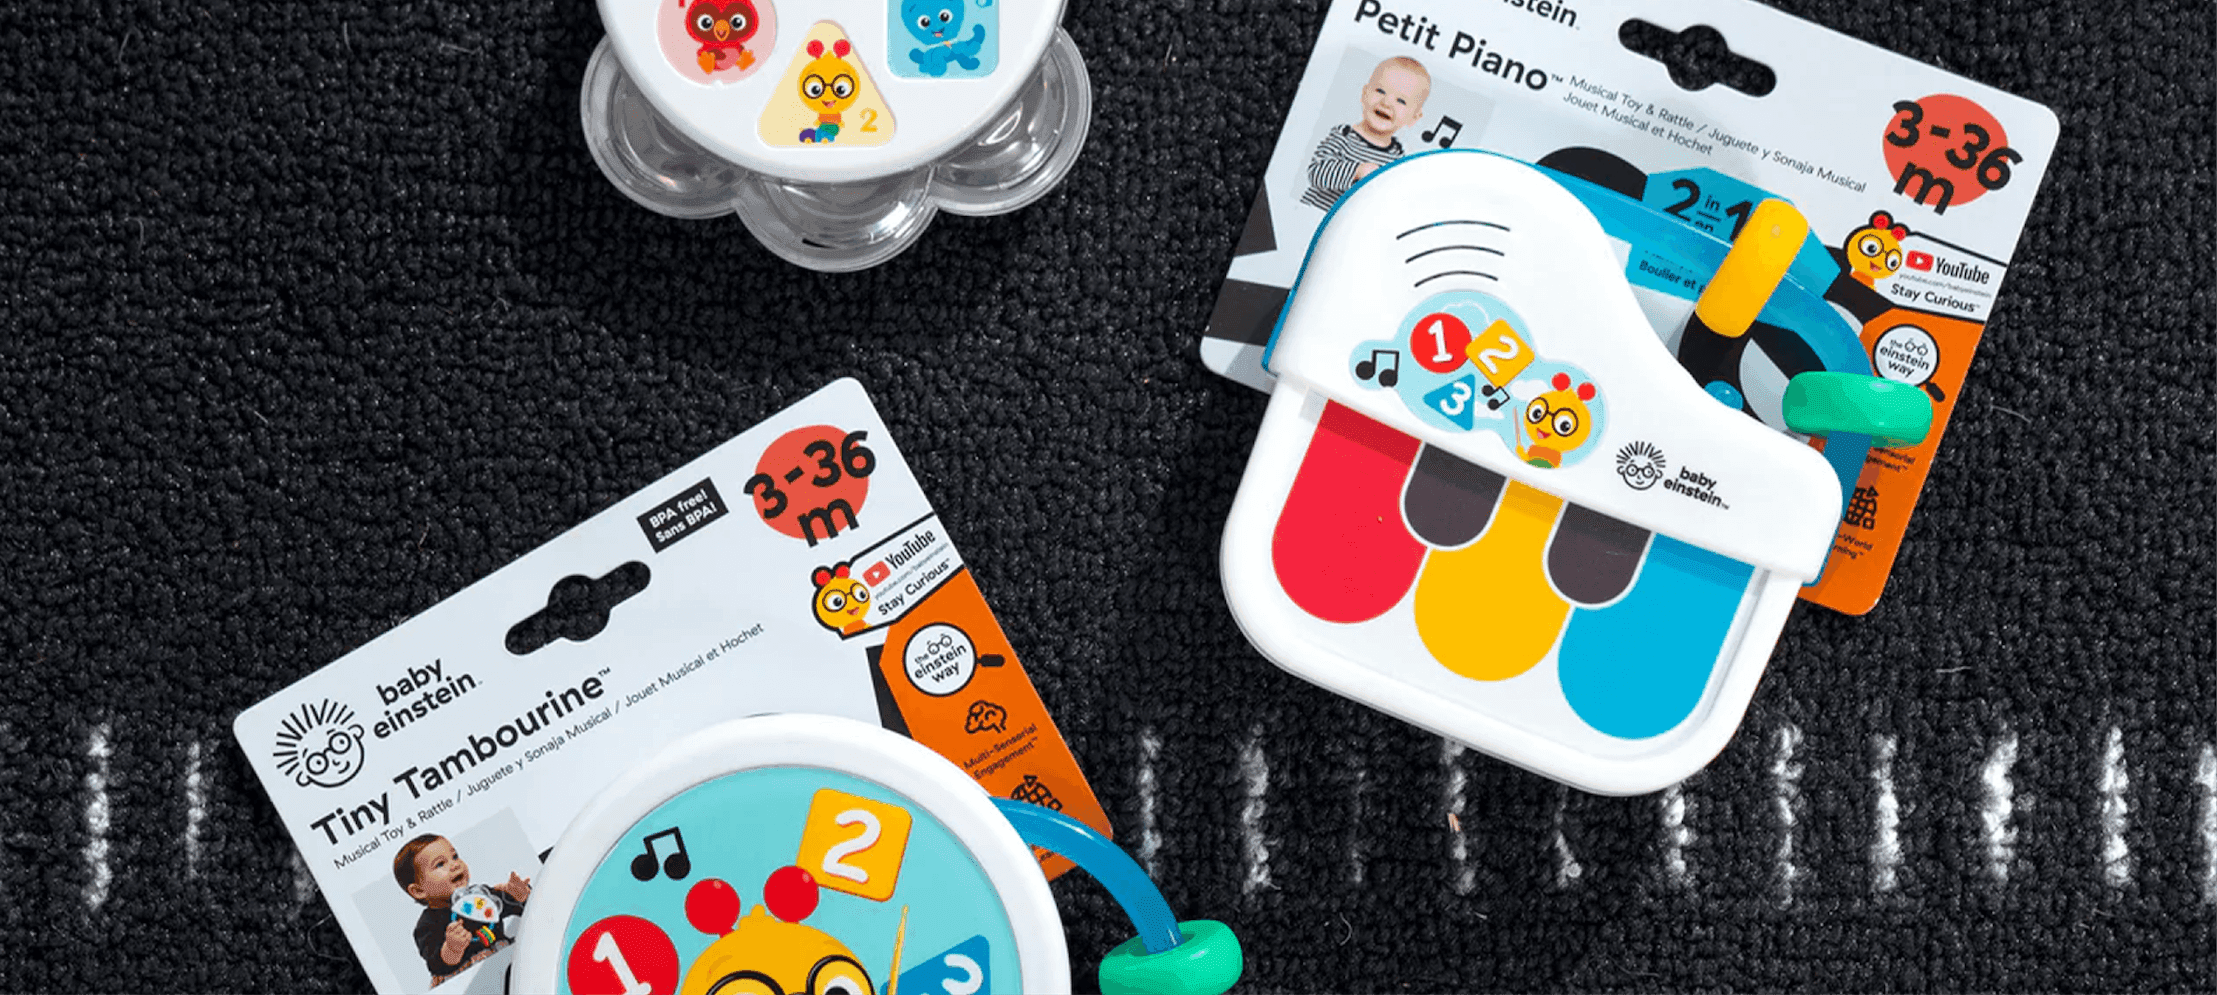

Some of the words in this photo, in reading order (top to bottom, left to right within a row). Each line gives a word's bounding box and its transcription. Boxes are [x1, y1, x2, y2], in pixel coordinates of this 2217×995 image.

[1354, 0, 1440, 51] Petit
[1502, 0, 1578, 27] stein
[860, 107, 878, 132] 2
[1563, 92, 1598, 112] Jouet
[1601, 105, 1650, 131] Musical
[1651, 126, 1664, 138] et
[1667, 130, 1713, 155] Hochet
[1569, 75, 1618, 101] Musical
[1622, 93, 1643, 112] Toy
[1646, 103, 1654, 115] &
[1658, 108, 1694, 130] Rattle
[1708, 128, 1759, 153] Juguete
[1761, 149, 1770, 160] y
[1772, 151, 1814, 174] Sonaja
[1817, 167, 1867, 193] Musical
[1885, 100, 2024, 191] 3-36
[1663, 178, 1701, 221] 2
[1705, 195, 1720, 211] in
[1894, 159, 1956, 216] m
[1936, 257, 1990, 284] YouTube
[1891, 283, 1921, 302] Stay
[1428, 320, 1452, 363] 1
[1477, 335, 1520, 375] 2
[1879, 346, 1930, 371] einstein
[1889, 339, 1903, 349] the
[1888, 360, 1915, 378] way
[1439, 381, 1472, 416] 3
[743, 430, 876, 519] 3-36
[1680, 466, 1717, 491] baby
[649, 507, 678, 529] BPA
[677, 488, 708, 512] free!
[655, 521, 686, 543] Sans
[685, 501, 717, 526] BPA!
[797, 498, 859, 548] m
[885, 530, 936, 570] YouTube
[878, 593, 905, 615] Stay
[914, 645, 967, 679] einstein
[915, 653, 929, 664] the
[932, 662, 959, 683] way
[376, 658, 443, 706] baby
[333, 838, 381, 870] Musical
[381, 825, 404, 845] Toy
[406, 818, 417, 829] &
[417, 799, 454, 822] Rattle
[465, 763, 514, 796] Juguete
[515, 759, 525, 771] y
[524, 736, 565, 763] Sonaja
[565, 707, 613, 740] Musical
[625, 683, 659, 707] Jouet
[658, 656, 706, 687] Musical
[706, 648, 720, 661] et
[719, 622, 765, 652] Hochet
[964, 723, 1038, 770] Multi-Sensorial
[310, 792, 390, 846] Tiny
[592, 931, 652, 995] 1
[822, 809, 882, 884] 2
